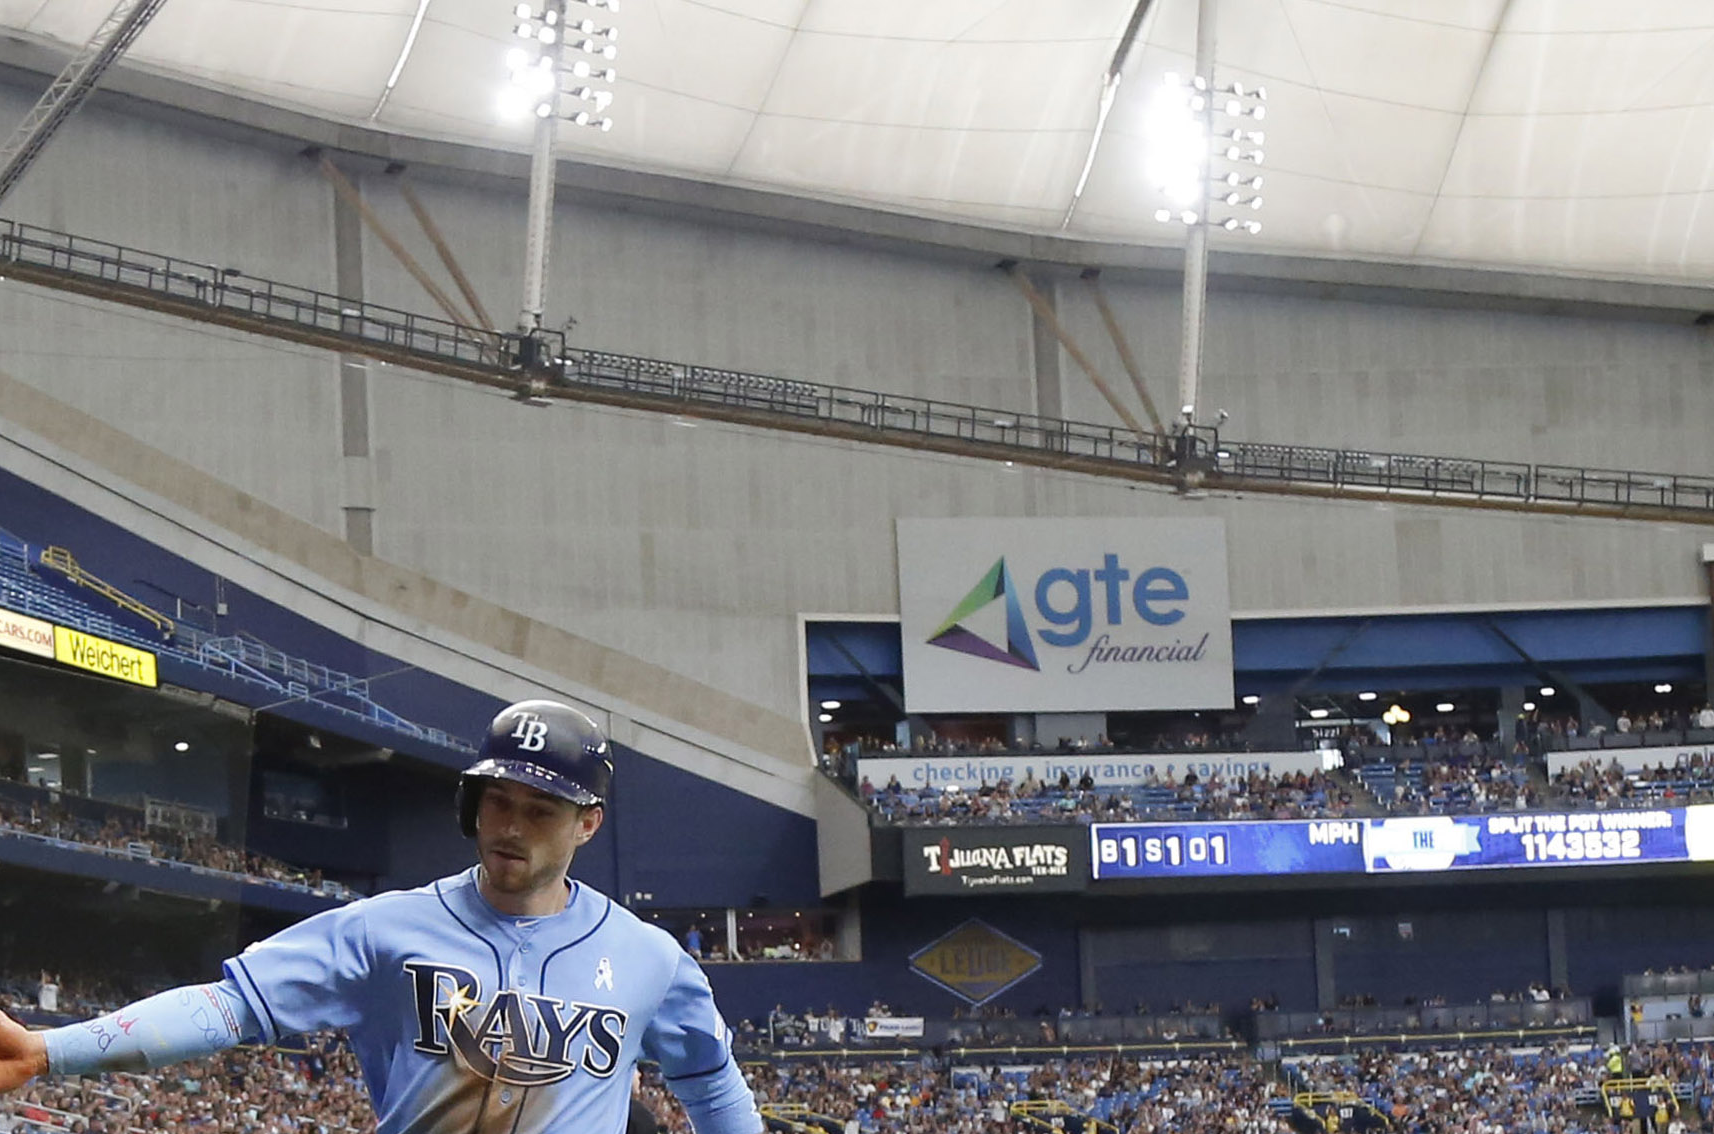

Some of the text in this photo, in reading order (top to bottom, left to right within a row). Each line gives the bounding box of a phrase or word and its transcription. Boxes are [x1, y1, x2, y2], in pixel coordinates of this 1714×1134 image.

[1034, 553, 1190, 648] gte
[68, 631, 144, 682] Weichert
[1067, 632, 1210, 675] financial
[511, 711, 548, 752] TB
[912, 759, 1271, 784] checking insurance savings
[1308, 822, 1359, 845] MPH
[1488, 817, 1533, 834] SPLIT
[1535, 815, 1566, 832] THE
[1569, 814, 1600, 831] POT
[1100, 839, 1118, 863] B
[1121, 837, 1136, 867] 1
[1144, 838, 1163, 862] S
[1166, 836, 1180, 866] 1
[1210, 835, 1225, 865] 1
[1413, 831, 1434, 849] THE
[1012, 844, 1068, 867] FLATS
